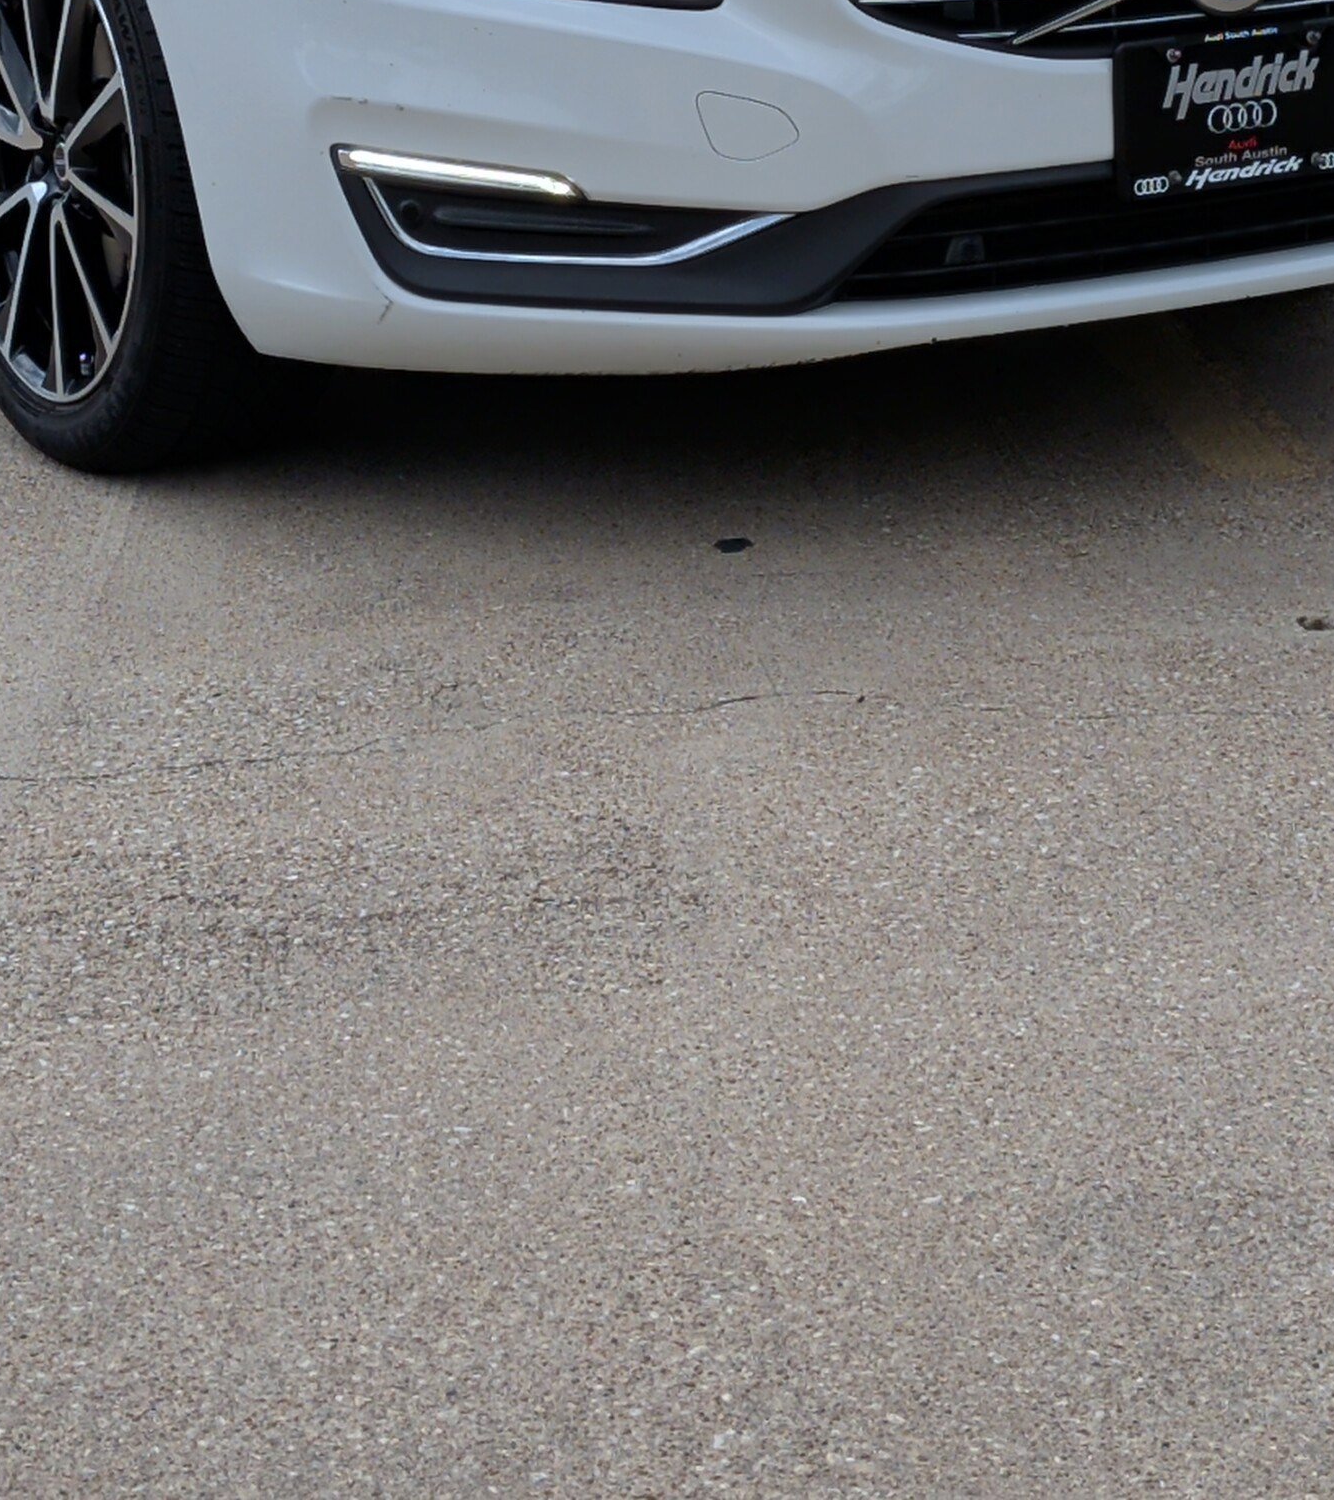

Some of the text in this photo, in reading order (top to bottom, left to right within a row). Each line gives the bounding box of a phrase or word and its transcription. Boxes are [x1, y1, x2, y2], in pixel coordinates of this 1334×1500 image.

[1162, 49, 1319, 120] Hendrick
[1194, 144, 1288, 167] South Austin
[1228, 136, 1257, 150] Audi
[1185, 155, 1304, 190] Hendrick
